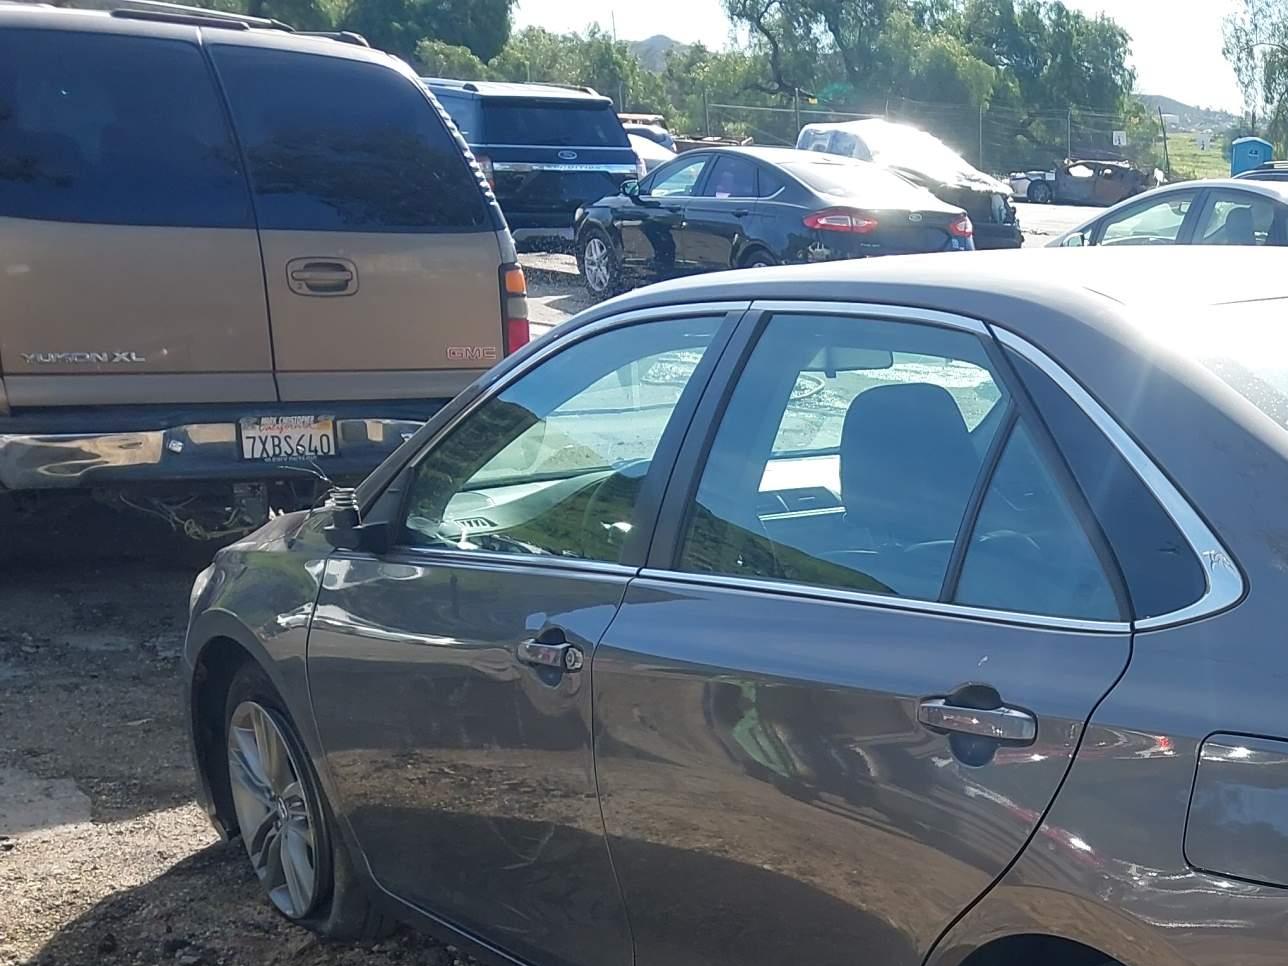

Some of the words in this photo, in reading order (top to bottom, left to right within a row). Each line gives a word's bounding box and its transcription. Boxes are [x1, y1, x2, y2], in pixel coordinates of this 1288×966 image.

[112, 352, 145, 362] XL
[447, 346, 497, 360] GMC
[245, 433, 331, 459] 7XBS640
